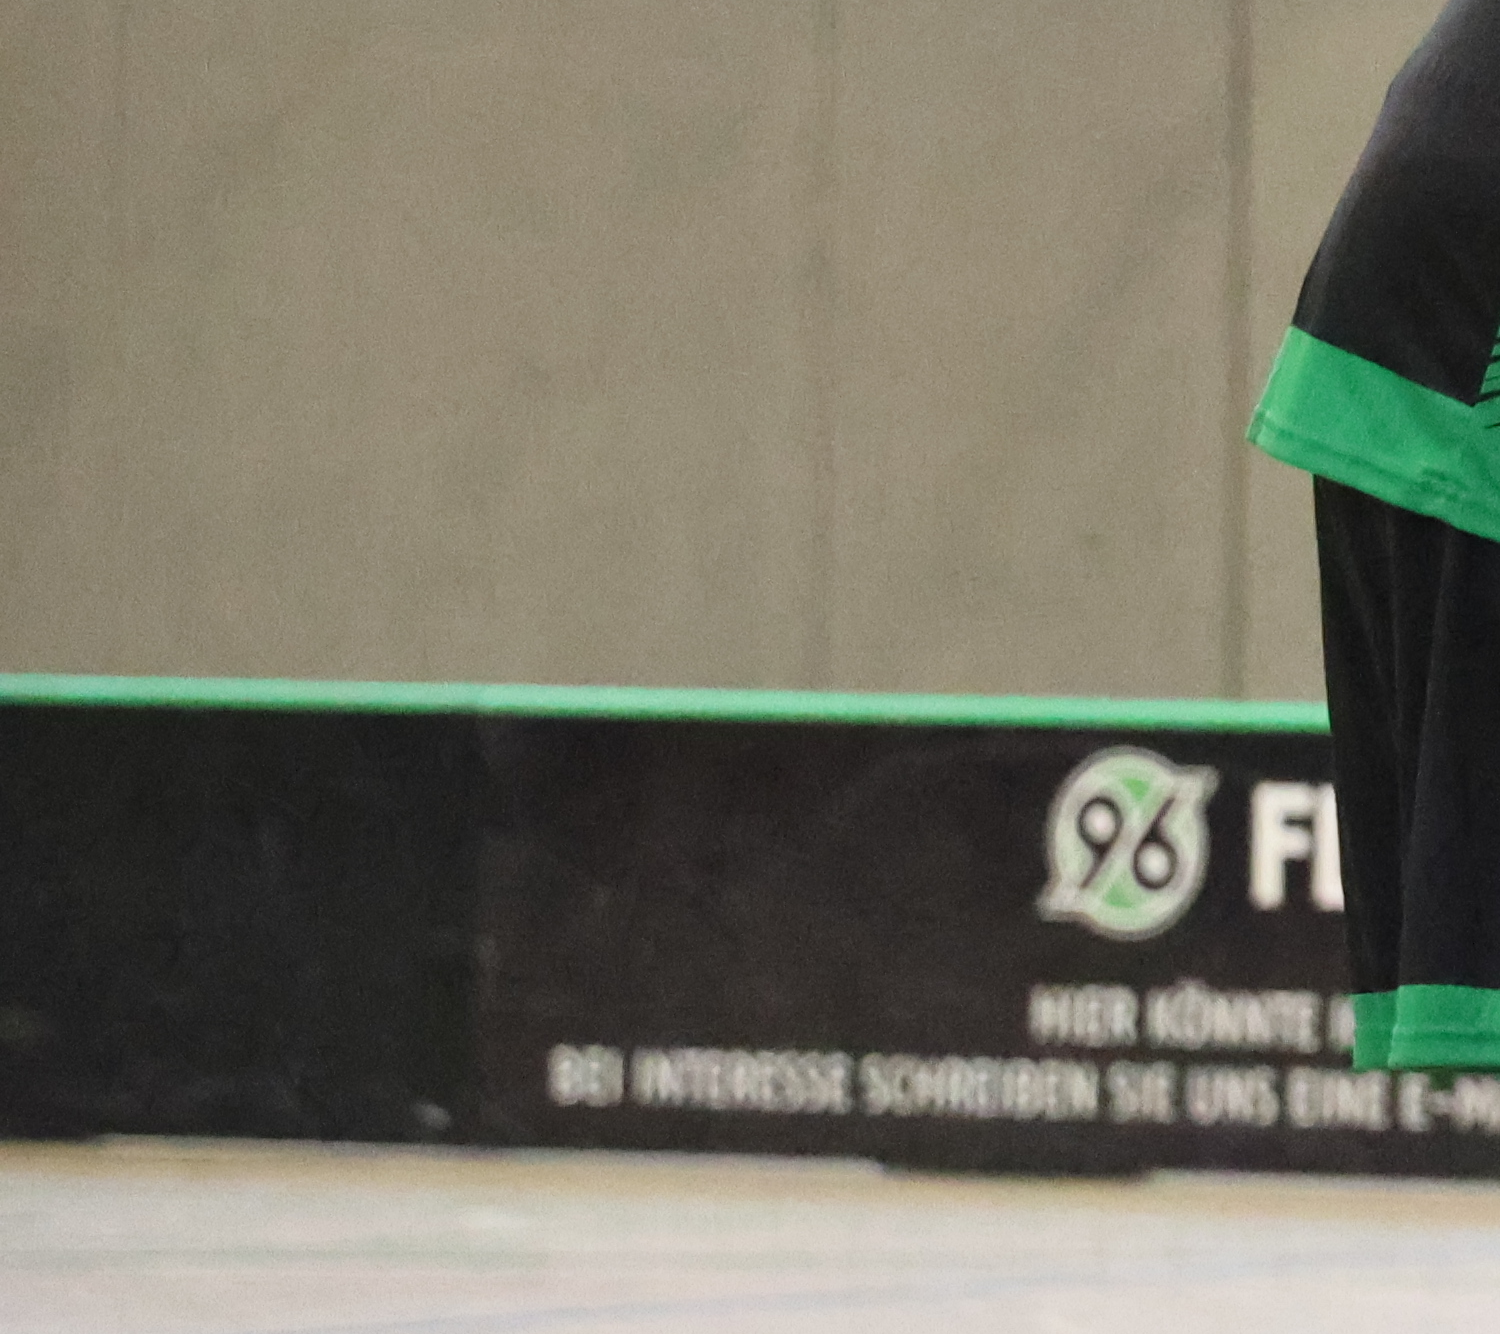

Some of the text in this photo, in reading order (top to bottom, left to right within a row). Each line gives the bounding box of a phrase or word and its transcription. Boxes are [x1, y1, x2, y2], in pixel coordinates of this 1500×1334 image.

[1036, 744, 1219, 942] 96
[1029, 983, 1139, 1047] HIER
[1145, 977, 1323, 1054] KÖNNTE
[547, 1043, 625, 1107] BEI
[632, 1047, 853, 1116] INTERESSE
[857, 1053, 1099, 1122] SCHREIBEN
[1105, 1060, 1175, 1123] SIE
[1184, 1063, 1280, 1128] UNS
[1286, 1067, 1391, 1129] EINE
